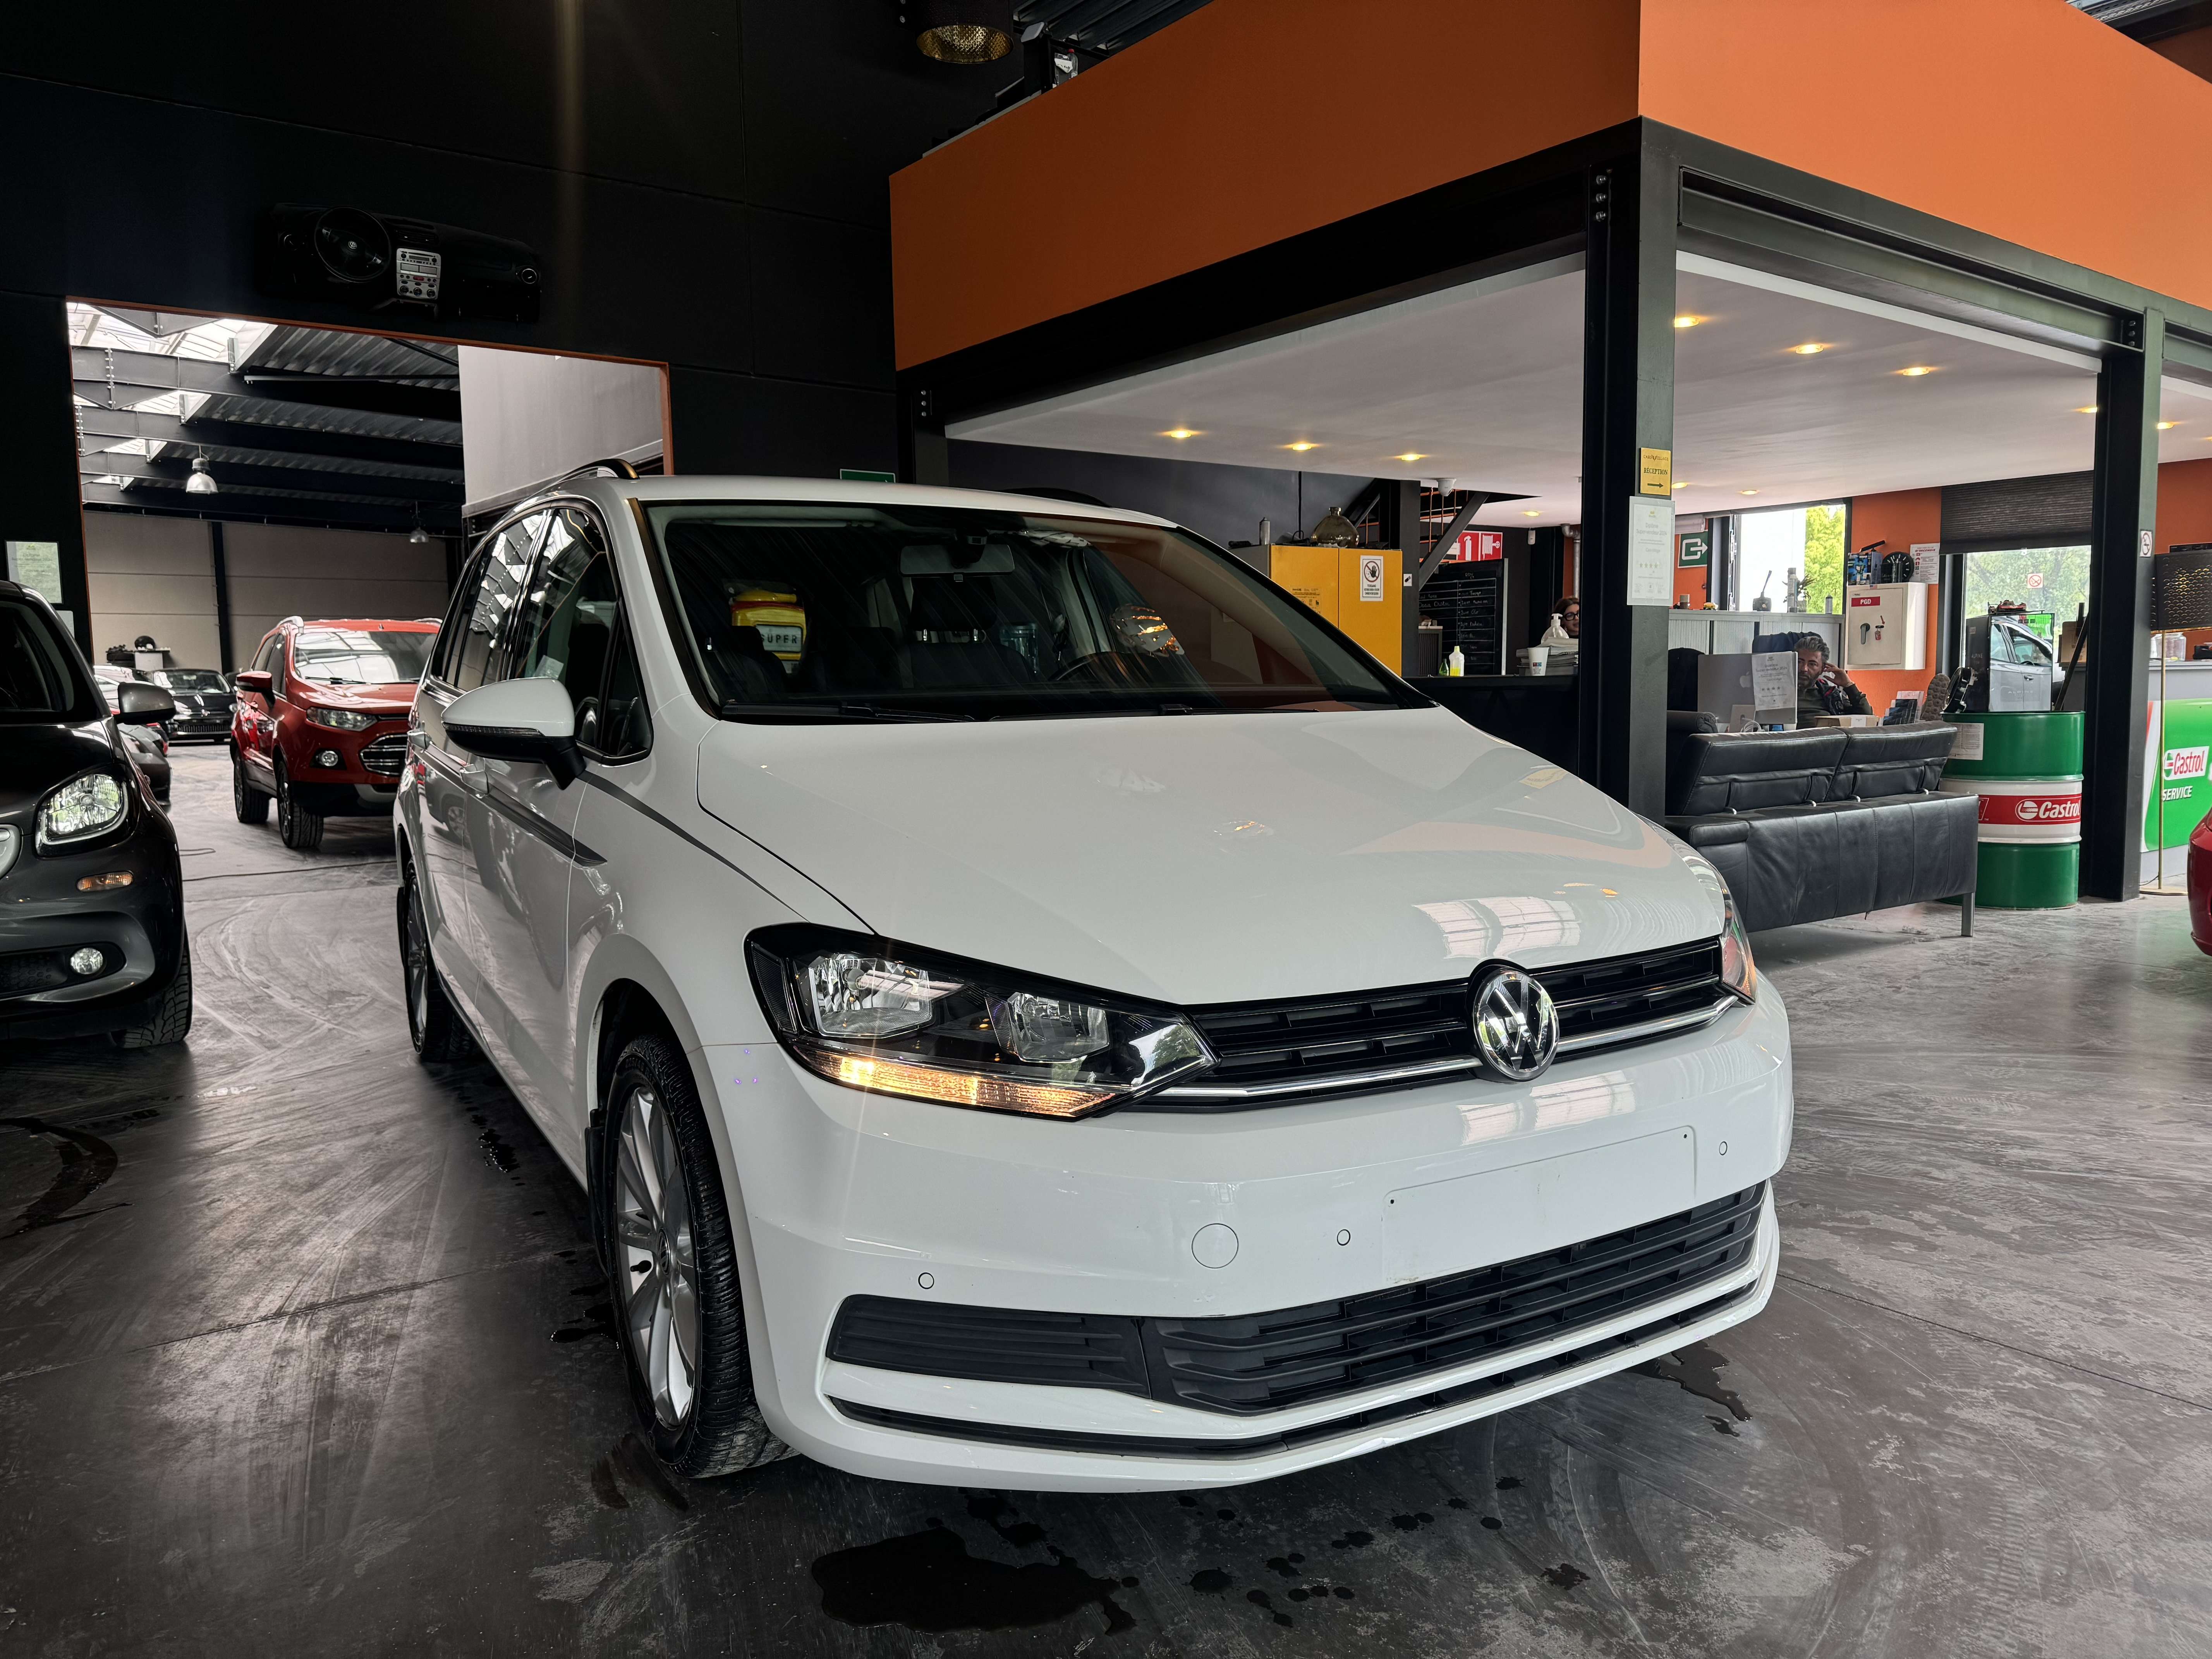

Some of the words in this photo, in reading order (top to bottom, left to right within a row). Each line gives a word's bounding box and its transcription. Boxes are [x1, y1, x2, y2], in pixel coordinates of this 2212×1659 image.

[1644, 466, 1668, 475] RÉCEPTION
[2174, 750, 2205, 775] Castrol
[2162, 785, 2193, 801] SERVICE
[2039, 799, 2081, 819] Castrol
